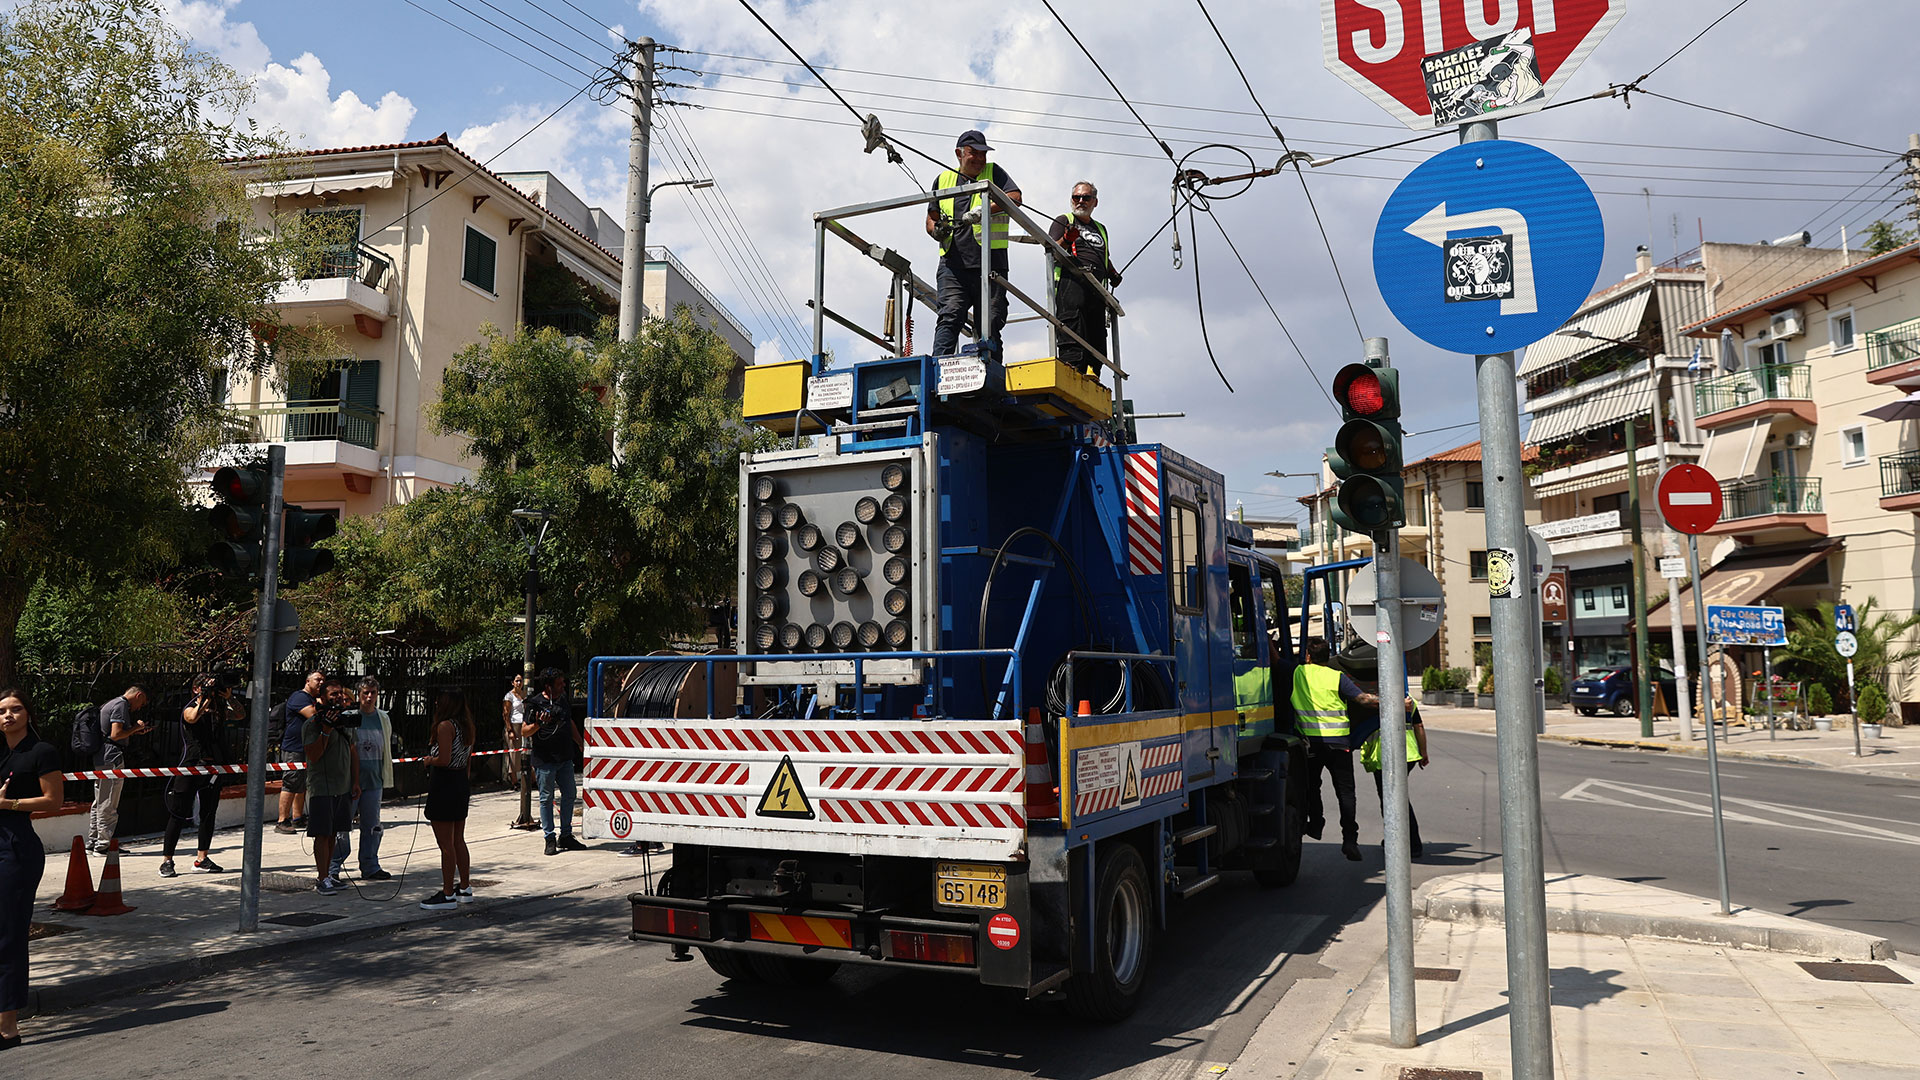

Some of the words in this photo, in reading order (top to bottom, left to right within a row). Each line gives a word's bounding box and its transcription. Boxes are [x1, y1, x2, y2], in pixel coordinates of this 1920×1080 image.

[1424, 46, 1485, 73] ΒΑΖΕΛΕΣ
[1432, 71, 1487, 94] ΠΟΡΝΕΣ
[1449, 245, 1476, 257] OUR
[1478, 242, 1507, 254] CITY
[1447, 285, 1472, 297] OUR
[1474, 281, 1511, 295] RULES
[614, 816, 628, 831] 60
[944, 881, 998, 904] 65148
